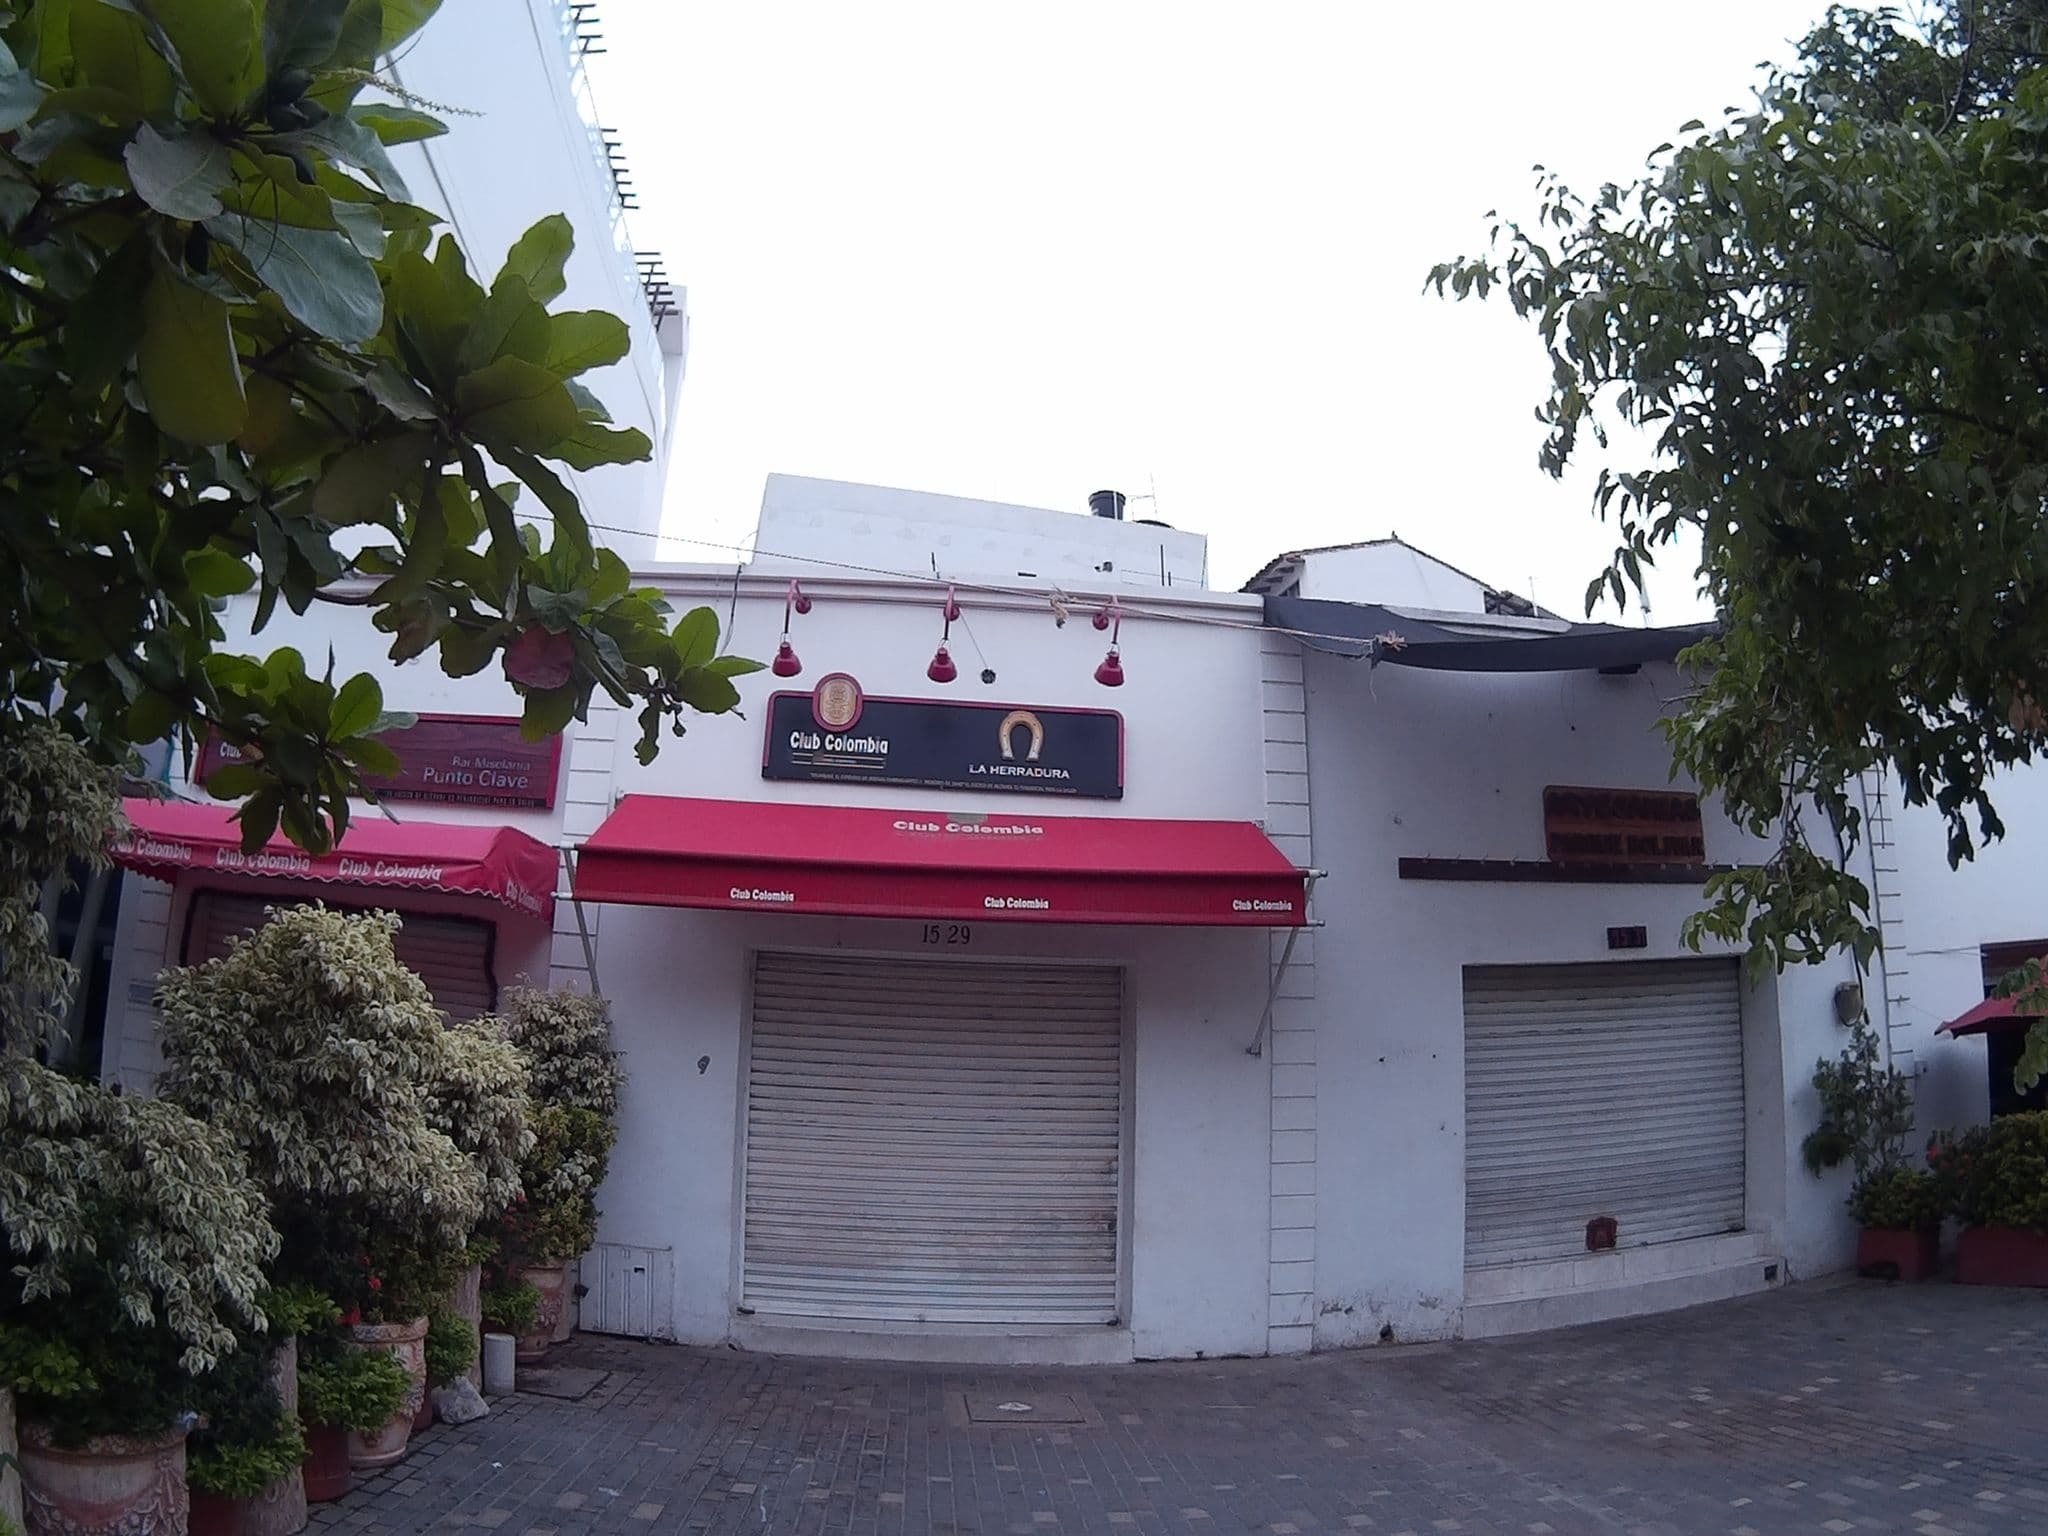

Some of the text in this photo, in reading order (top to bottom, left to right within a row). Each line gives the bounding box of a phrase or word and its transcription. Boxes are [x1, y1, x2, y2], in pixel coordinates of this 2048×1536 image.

[790, 731, 889, 754] Club Colombia
[452, 755, 471, 768] Bar
[423, 767, 529, 789] Punto Clave
[968, 764, 1070, 779] LA HERRADURA
[892, 820, 1044, 835] Club Colombia
[110, 838, 192, 860] lub Colombia
[216, 847, 244, 866] Club
[339, 858, 443, 881] Club Colombia
[730, 887, 795, 902] Club Colombia
[984, 896, 1049, 909] Club Colombia
[1232, 899, 1293, 911] Club Colombia
[922, 924, 971, 945] 15 29
